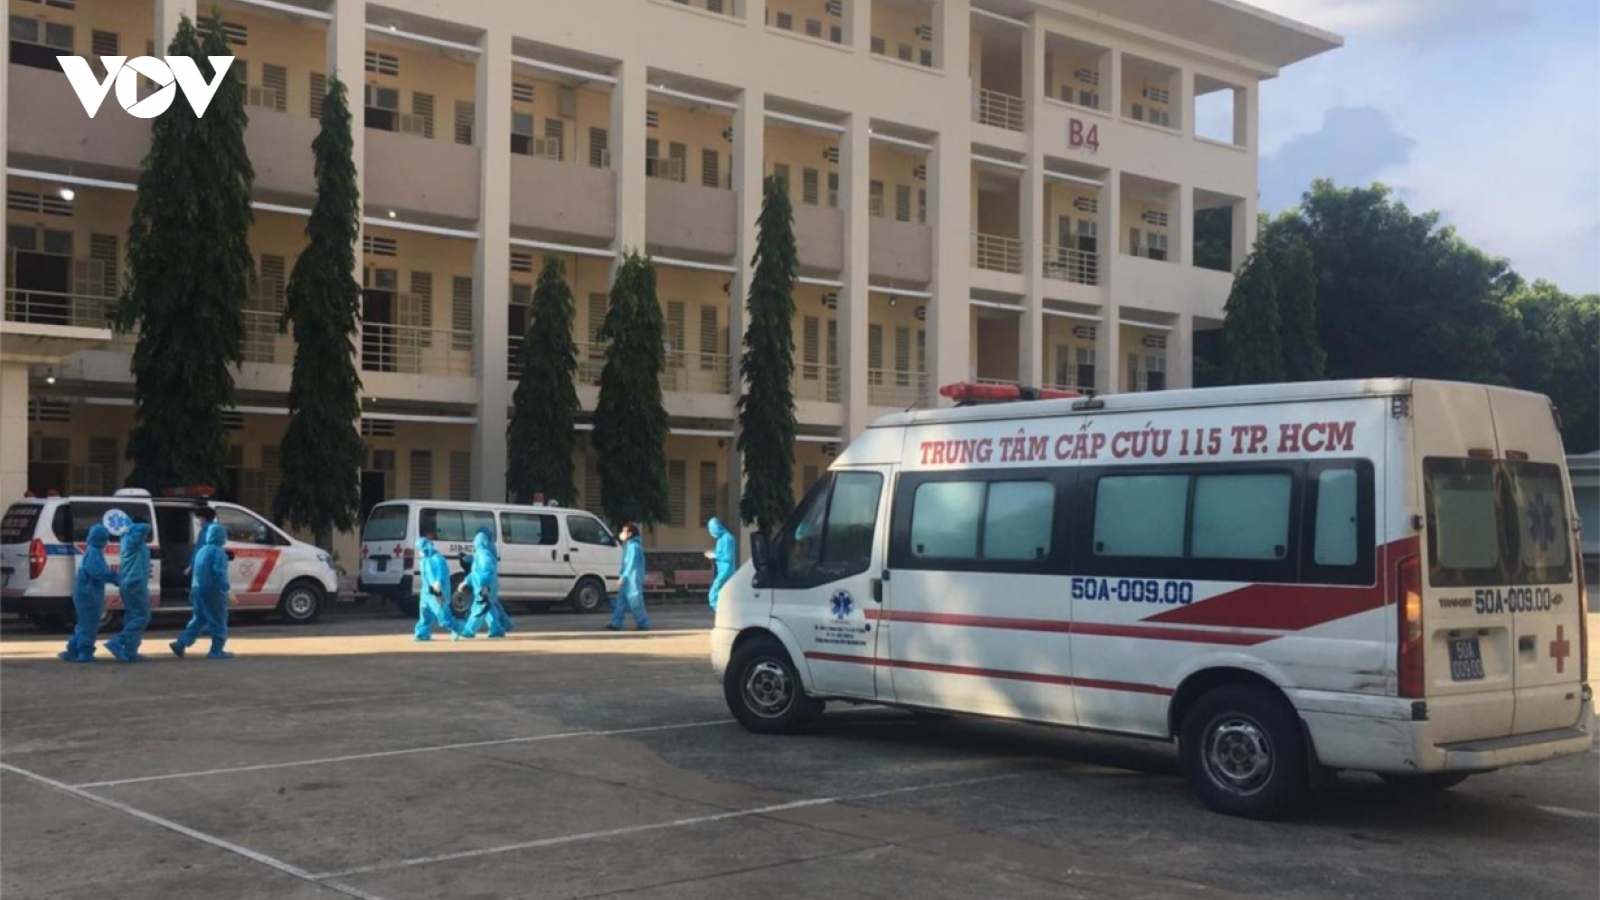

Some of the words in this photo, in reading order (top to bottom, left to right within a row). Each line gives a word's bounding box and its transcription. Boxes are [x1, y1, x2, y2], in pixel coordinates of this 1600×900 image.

[1068, 117, 1099, 153] B4
[920, 438, 993, 465] TRUNG
[999, 428, 1048, 462] TÂM
[1054, 420, 1106, 460] CẤP
[1110, 421, 1172, 458] CỨU
[1178, 427, 1222, 456] 115
[1231, 424, 1268, 454] TP.
[1276, 421, 1356, 452] HCM
[1071, 577, 1193, 605] 50A-009.00
[1475, 587, 1550, 614] 50A-009.00
[1456, 641, 1475, 659] 50A
